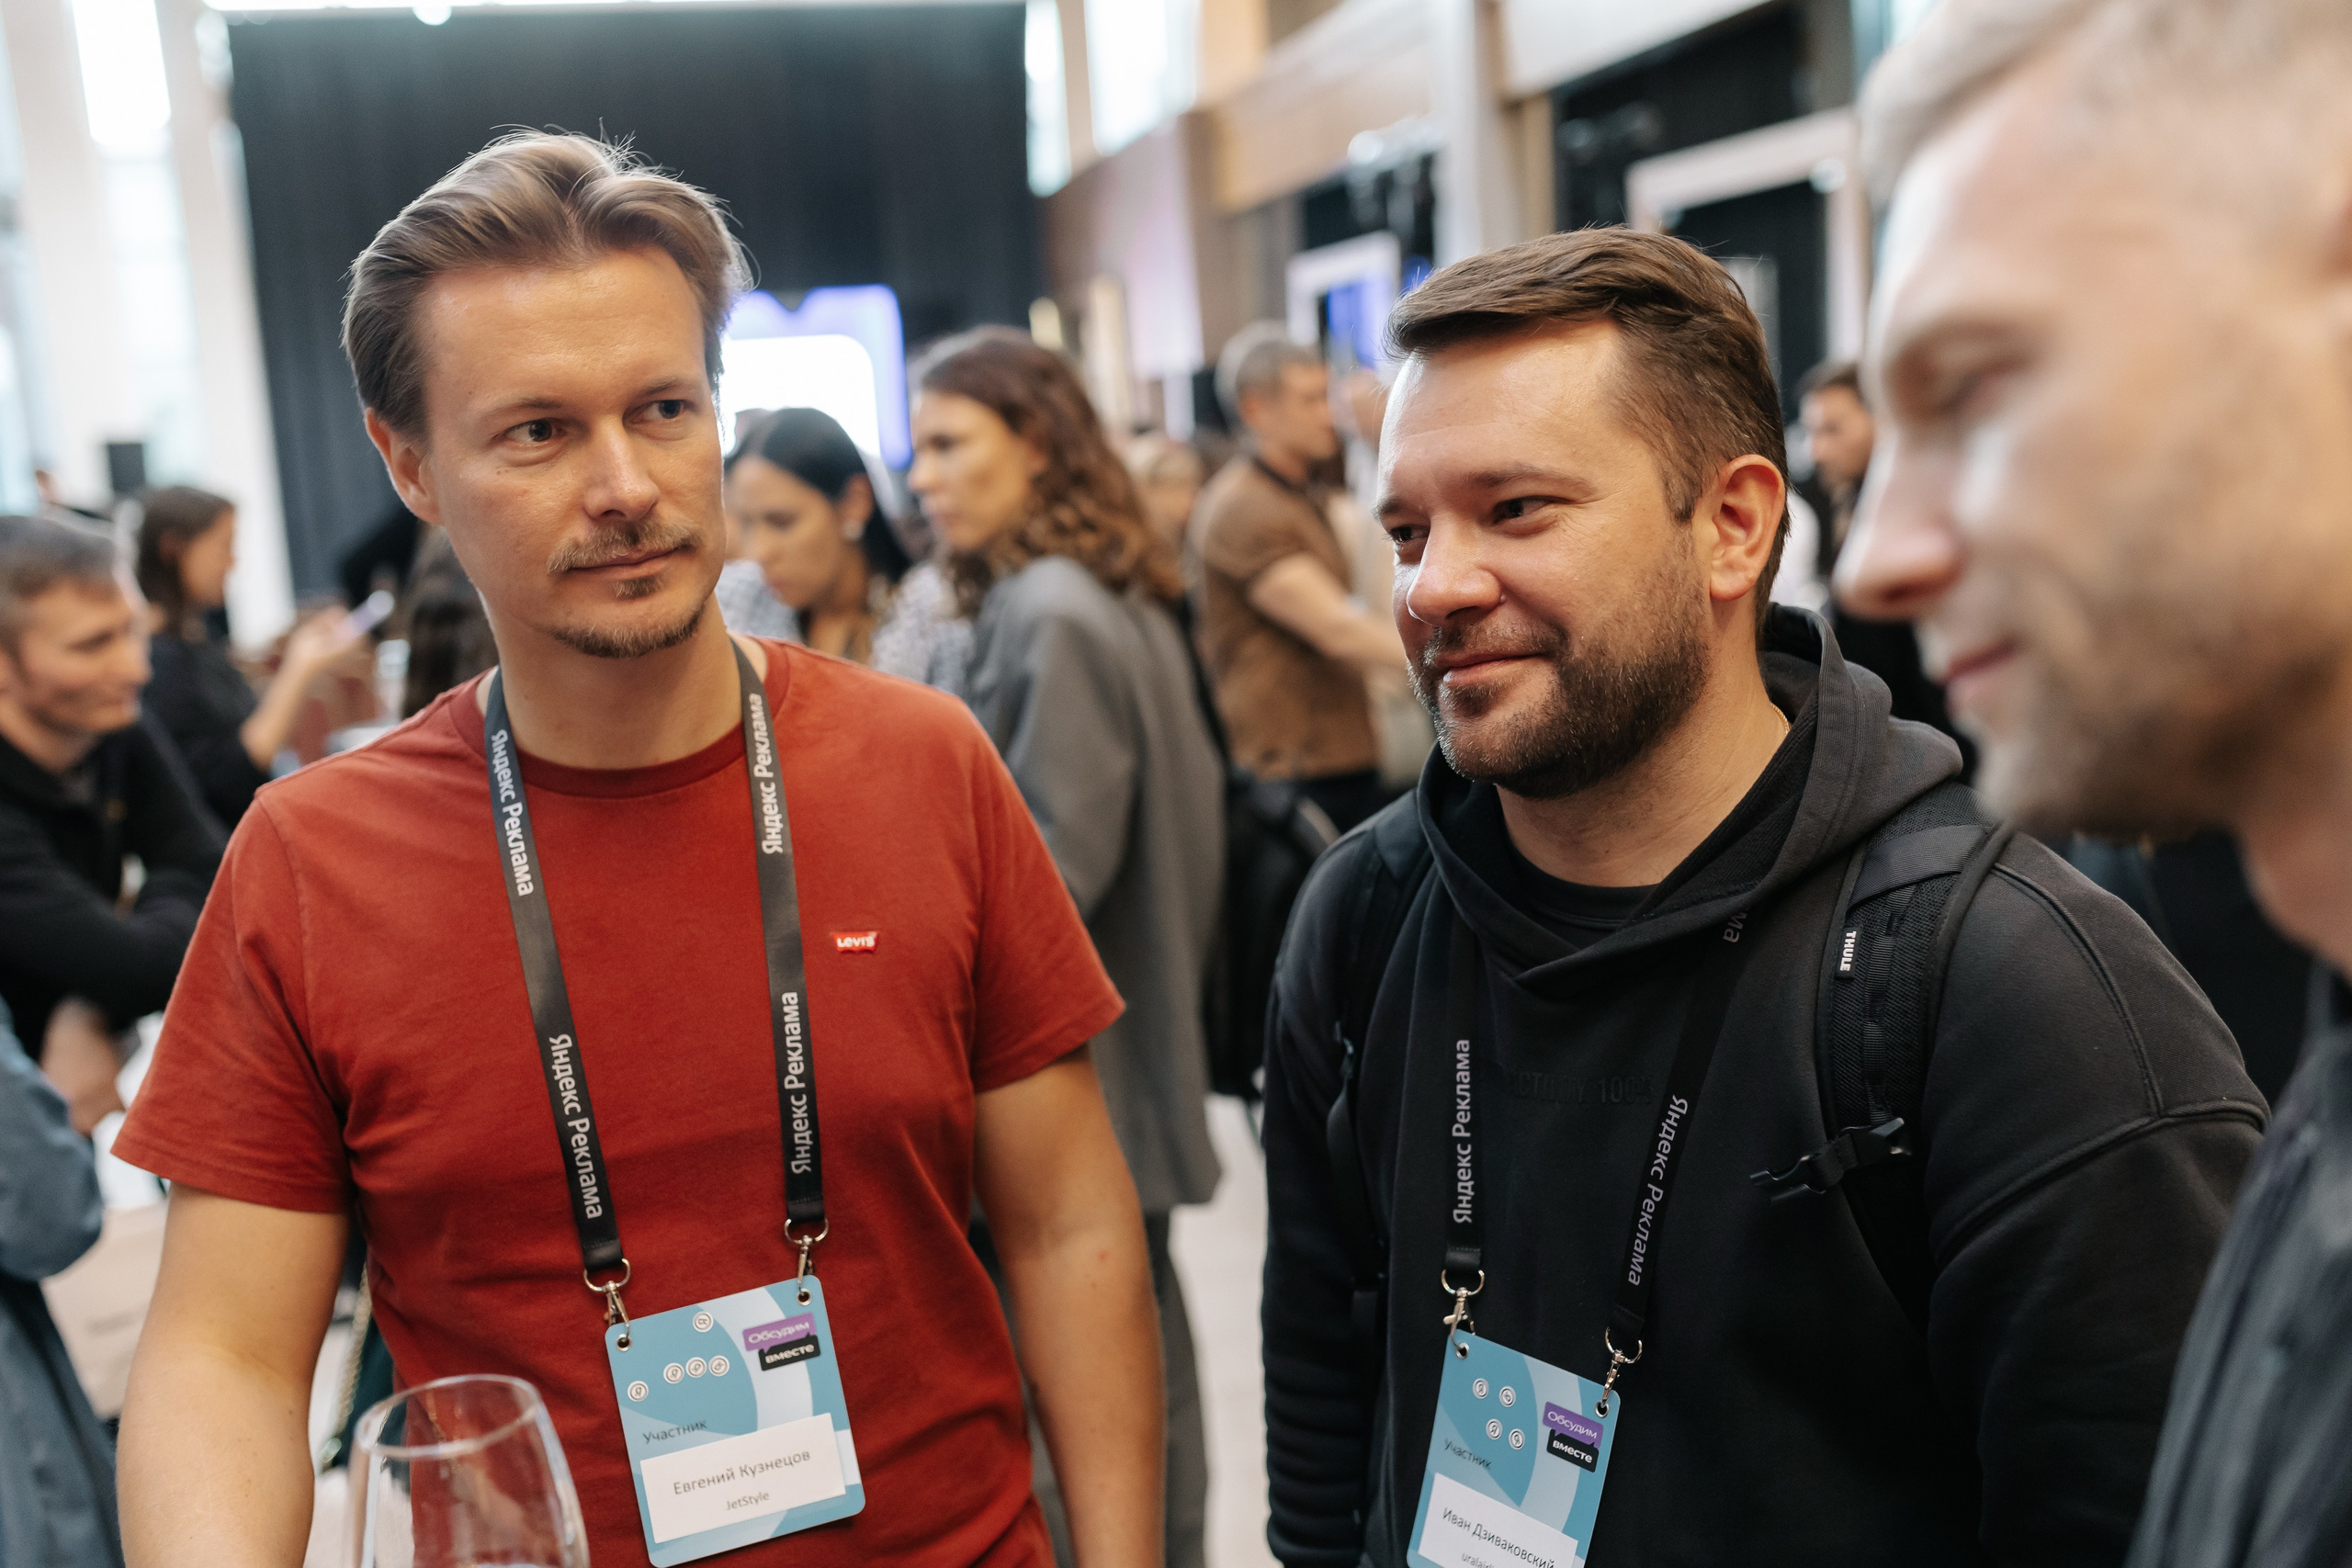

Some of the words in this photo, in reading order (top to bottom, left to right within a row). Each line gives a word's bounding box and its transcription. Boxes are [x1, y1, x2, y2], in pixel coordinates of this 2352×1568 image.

[491, 728, 515, 804] Яндекс
[748, 693, 774, 778] Реклама
[502, 802, 535, 897] Реклама
[761, 781, 784, 854] Яндекс
[1839, 931, 1858, 972] THULE
[781, 991, 807, 1089] Реклама
[1452, 1039, 1472, 1138] Реклама
[548, 1033, 582, 1116] Яндекс
[567, 1117, 603, 1220] Реклама
[790, 1093, 815, 1175] Яндекс
[1650, 1094, 1689, 1180] Яндекс
[1452, 1143, 1476, 1224] Яндекс
[1627, 1182, 1665, 1287] Реклама
[747, 1320, 811, 1344] Обсудим
[764, 1343, 815, 1364] вместе
[642, 1419, 708, 1444] Участник
[1443, 1438, 1492, 1471] Участник
[1547, 1411, 1598, 1439] Обсудим
[1552, 1439, 1593, 1463] вместе
[673, 1468, 737, 1495] Евгений
[738, 1450, 811, 1479] Кузнецов
[726, 1490, 771, 1511] JetStyle
[1442, 1506, 1472, 1532] Иван
[1471, 1523, 1555, 1568] Дзиваковский
